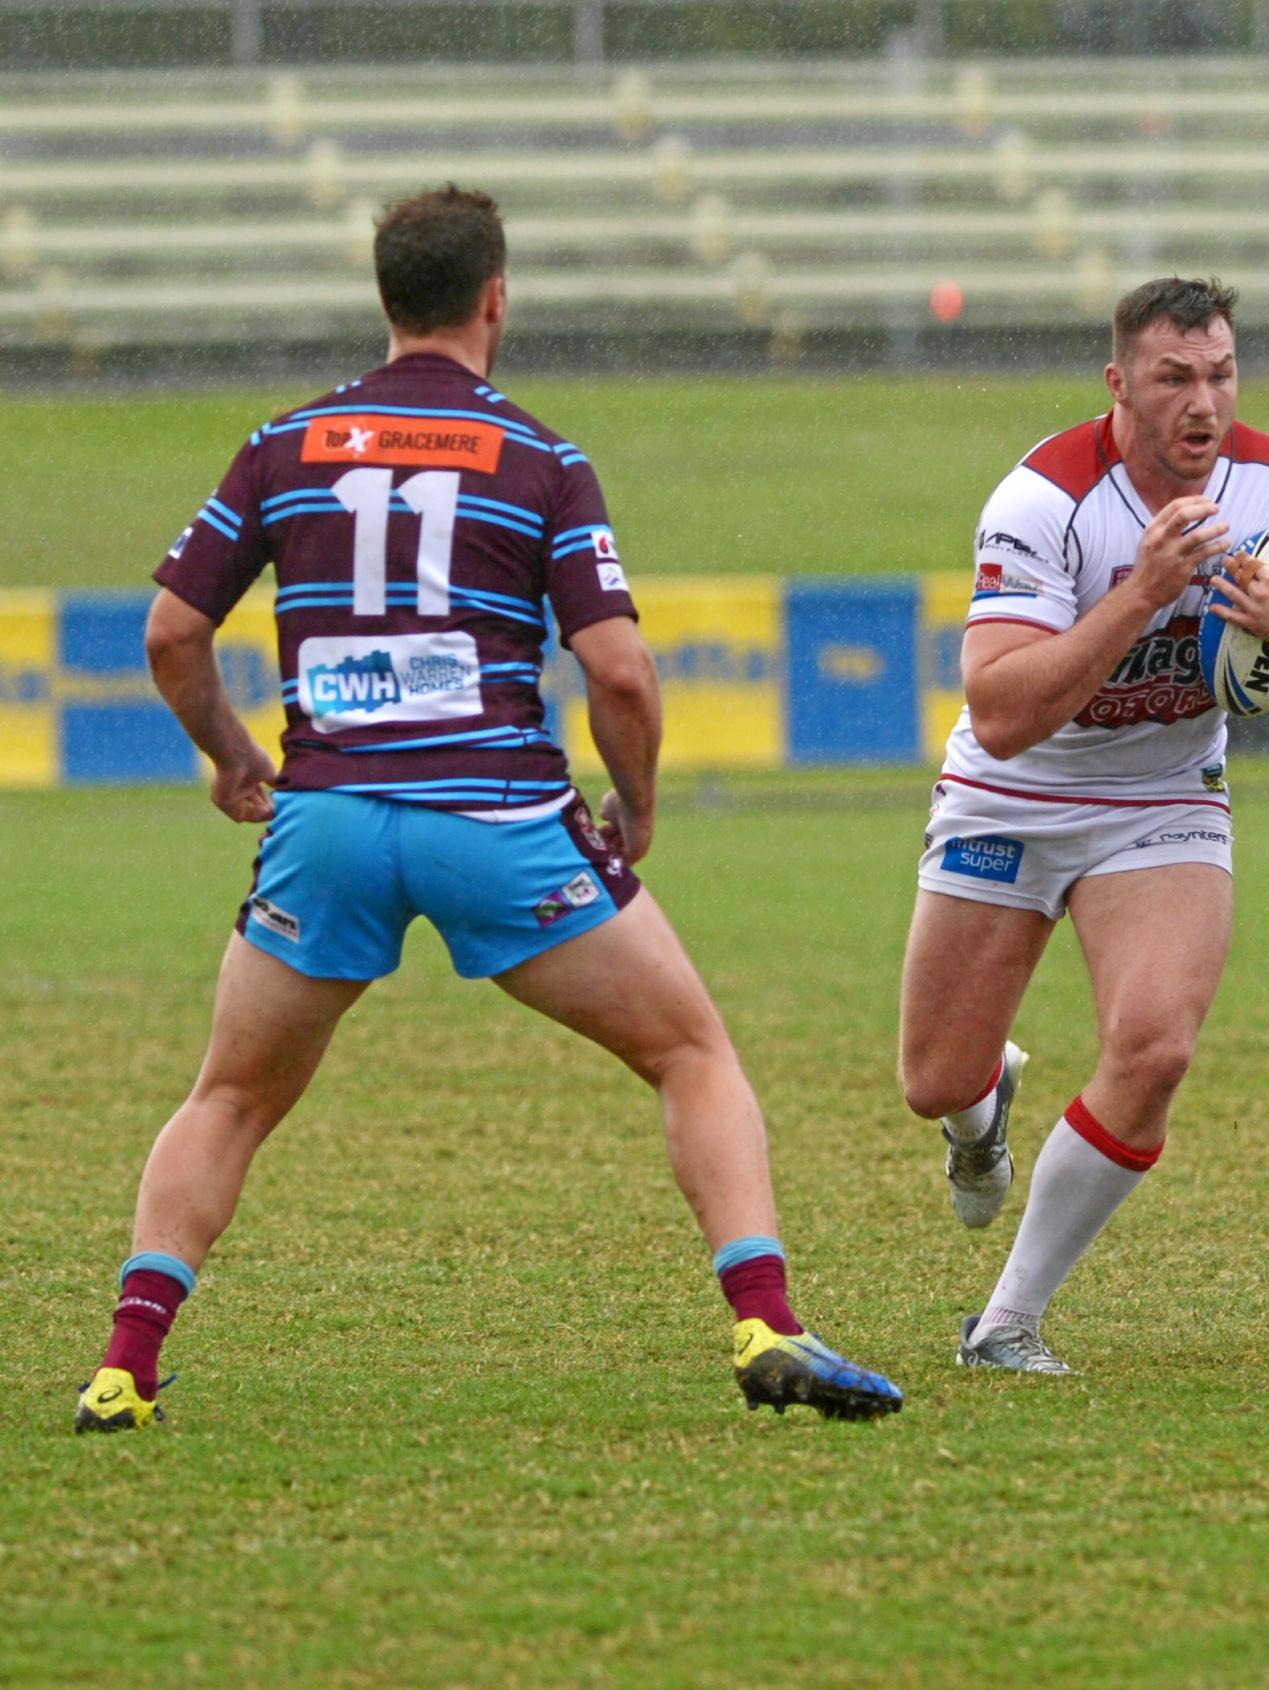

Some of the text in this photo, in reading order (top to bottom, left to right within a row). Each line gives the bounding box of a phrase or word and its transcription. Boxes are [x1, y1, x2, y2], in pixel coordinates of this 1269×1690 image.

[379, 430, 481, 454] GRACEMERE
[331, 468, 460, 616] 11
[409, 654, 459, 671] CHRIS
[401, 664, 472, 686] WARREN
[314, 672, 396, 702] CWH
[409, 679, 464, 695] HOMES
[960, 852, 1014, 872] super
